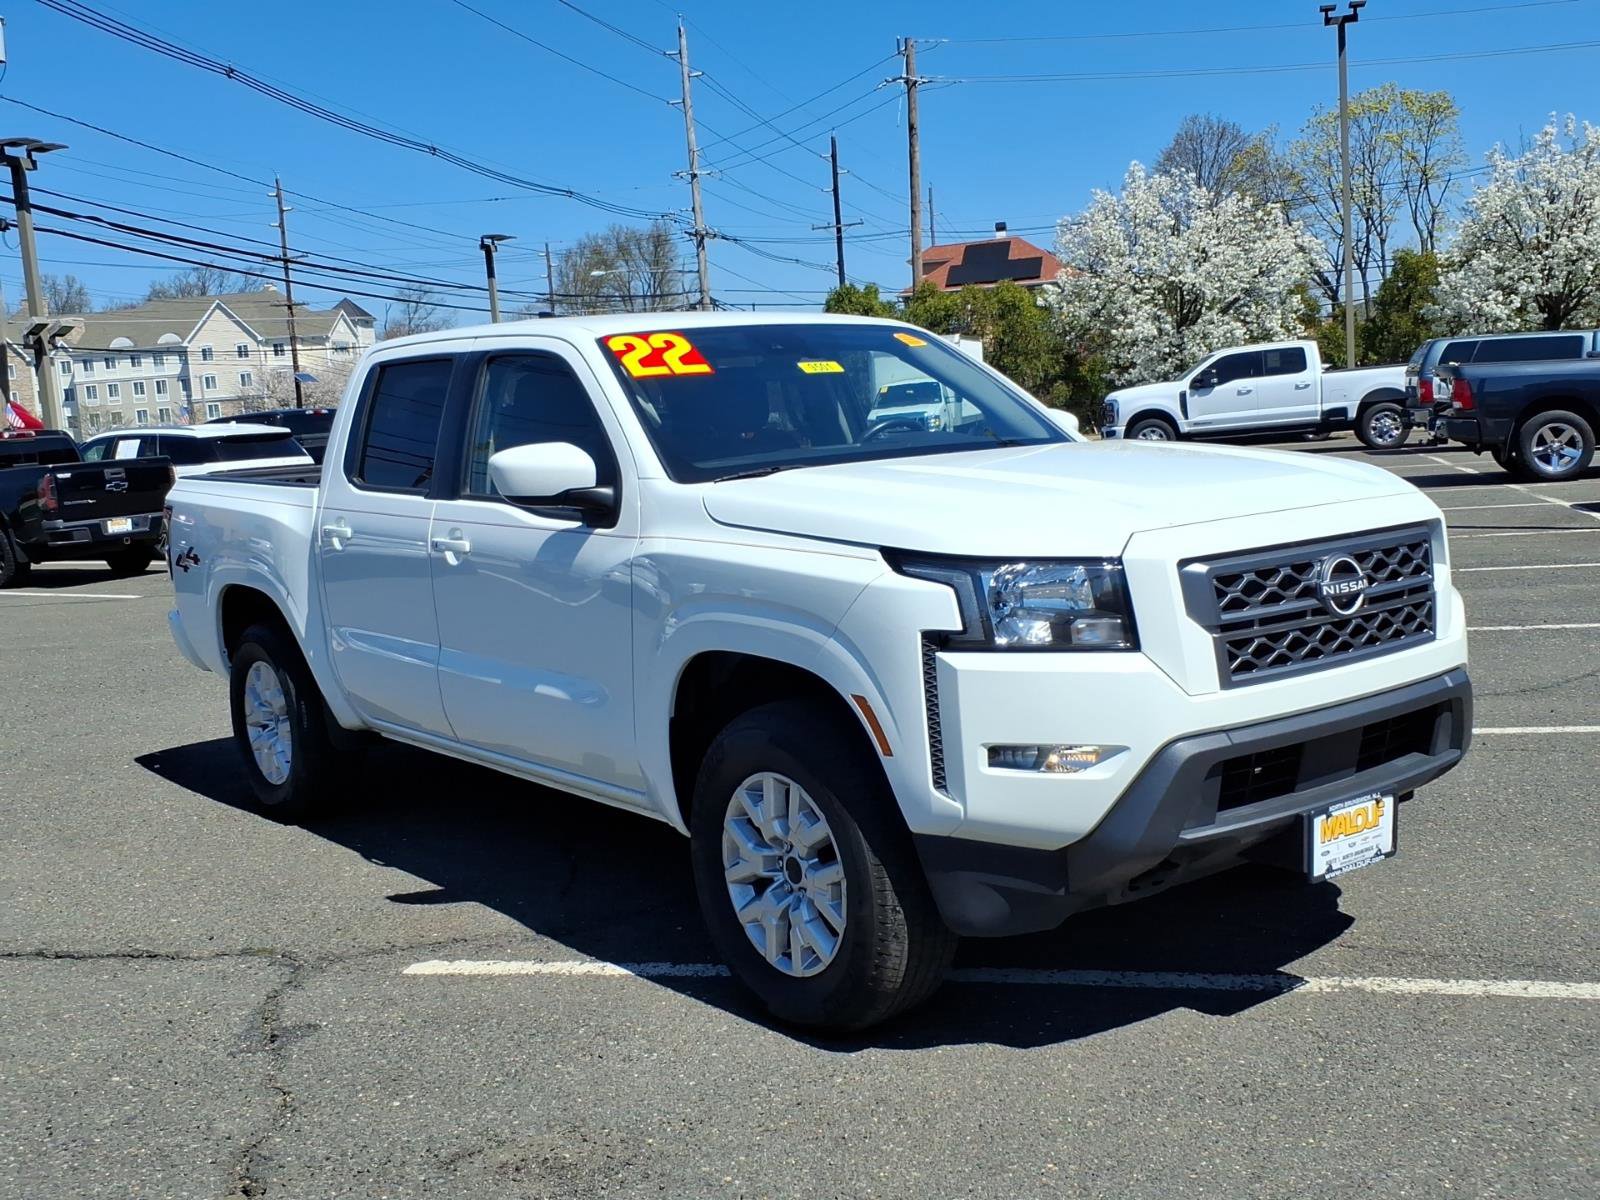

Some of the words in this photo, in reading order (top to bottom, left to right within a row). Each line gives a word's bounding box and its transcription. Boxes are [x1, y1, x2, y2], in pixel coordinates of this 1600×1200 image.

[607, 333, 712, 377] 22
[1322, 579, 1369, 595] NISSAN
[1320, 801, 1385, 844] MALOUF
